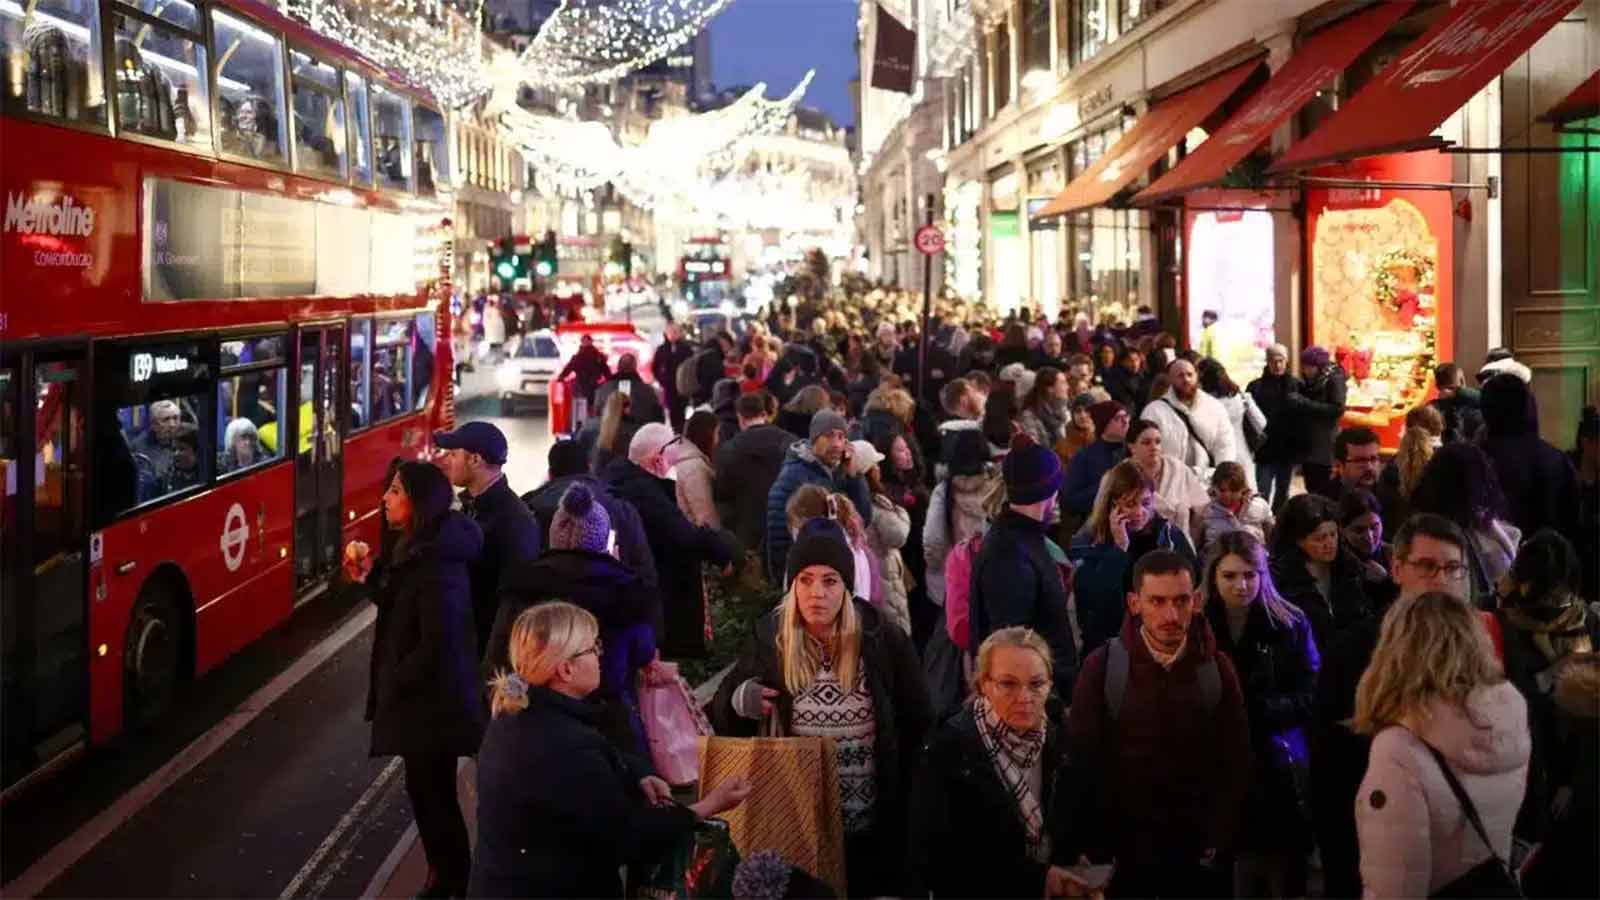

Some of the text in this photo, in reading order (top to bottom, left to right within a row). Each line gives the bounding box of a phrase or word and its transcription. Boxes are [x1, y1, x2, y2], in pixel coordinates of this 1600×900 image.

[4, 191, 96, 237] Metroline
[922, 233, 943, 246] 20
[133, 353, 153, 382] 139
